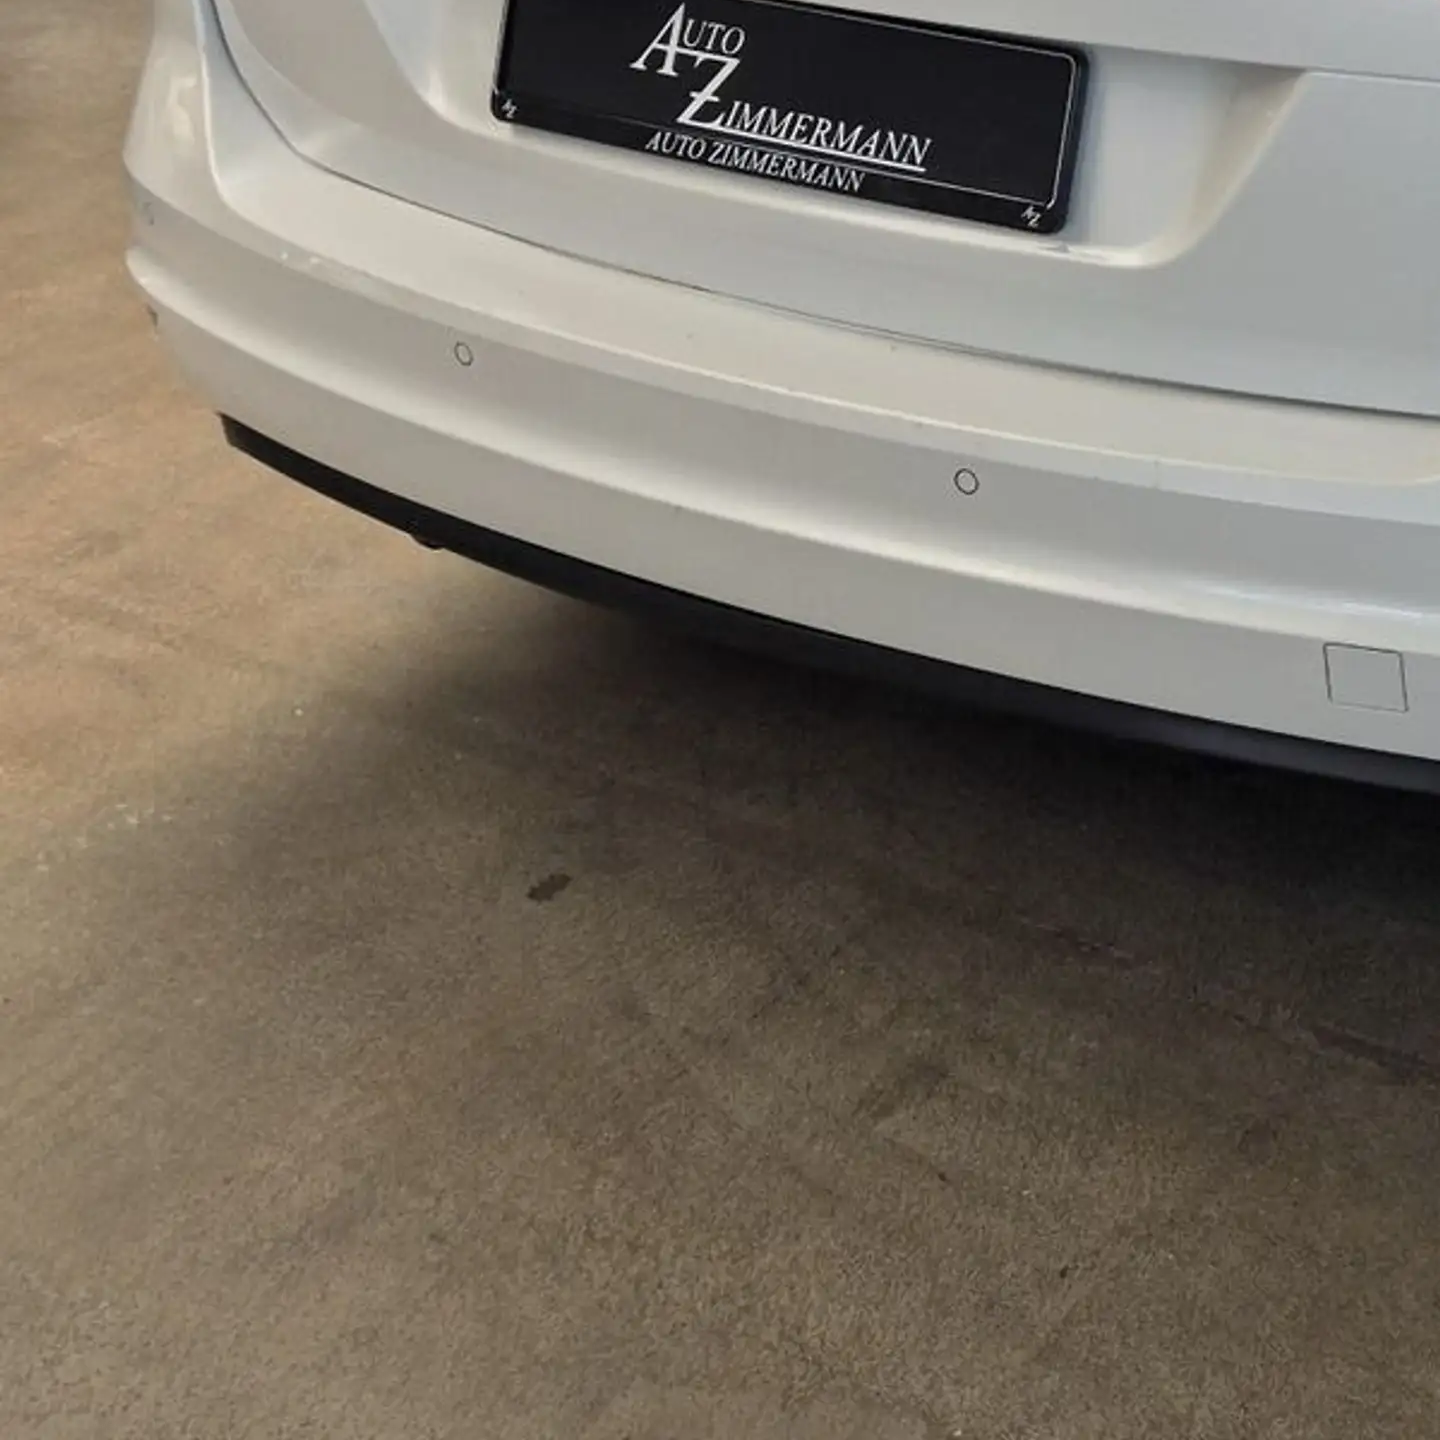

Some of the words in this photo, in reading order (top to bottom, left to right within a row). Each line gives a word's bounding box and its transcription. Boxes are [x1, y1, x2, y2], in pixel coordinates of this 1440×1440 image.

[676, 50, 932, 169] ZIMMERMANN
[645, 131, 707, 159] AUTO
[707, 141, 865, 192] ZIMMERMANN
